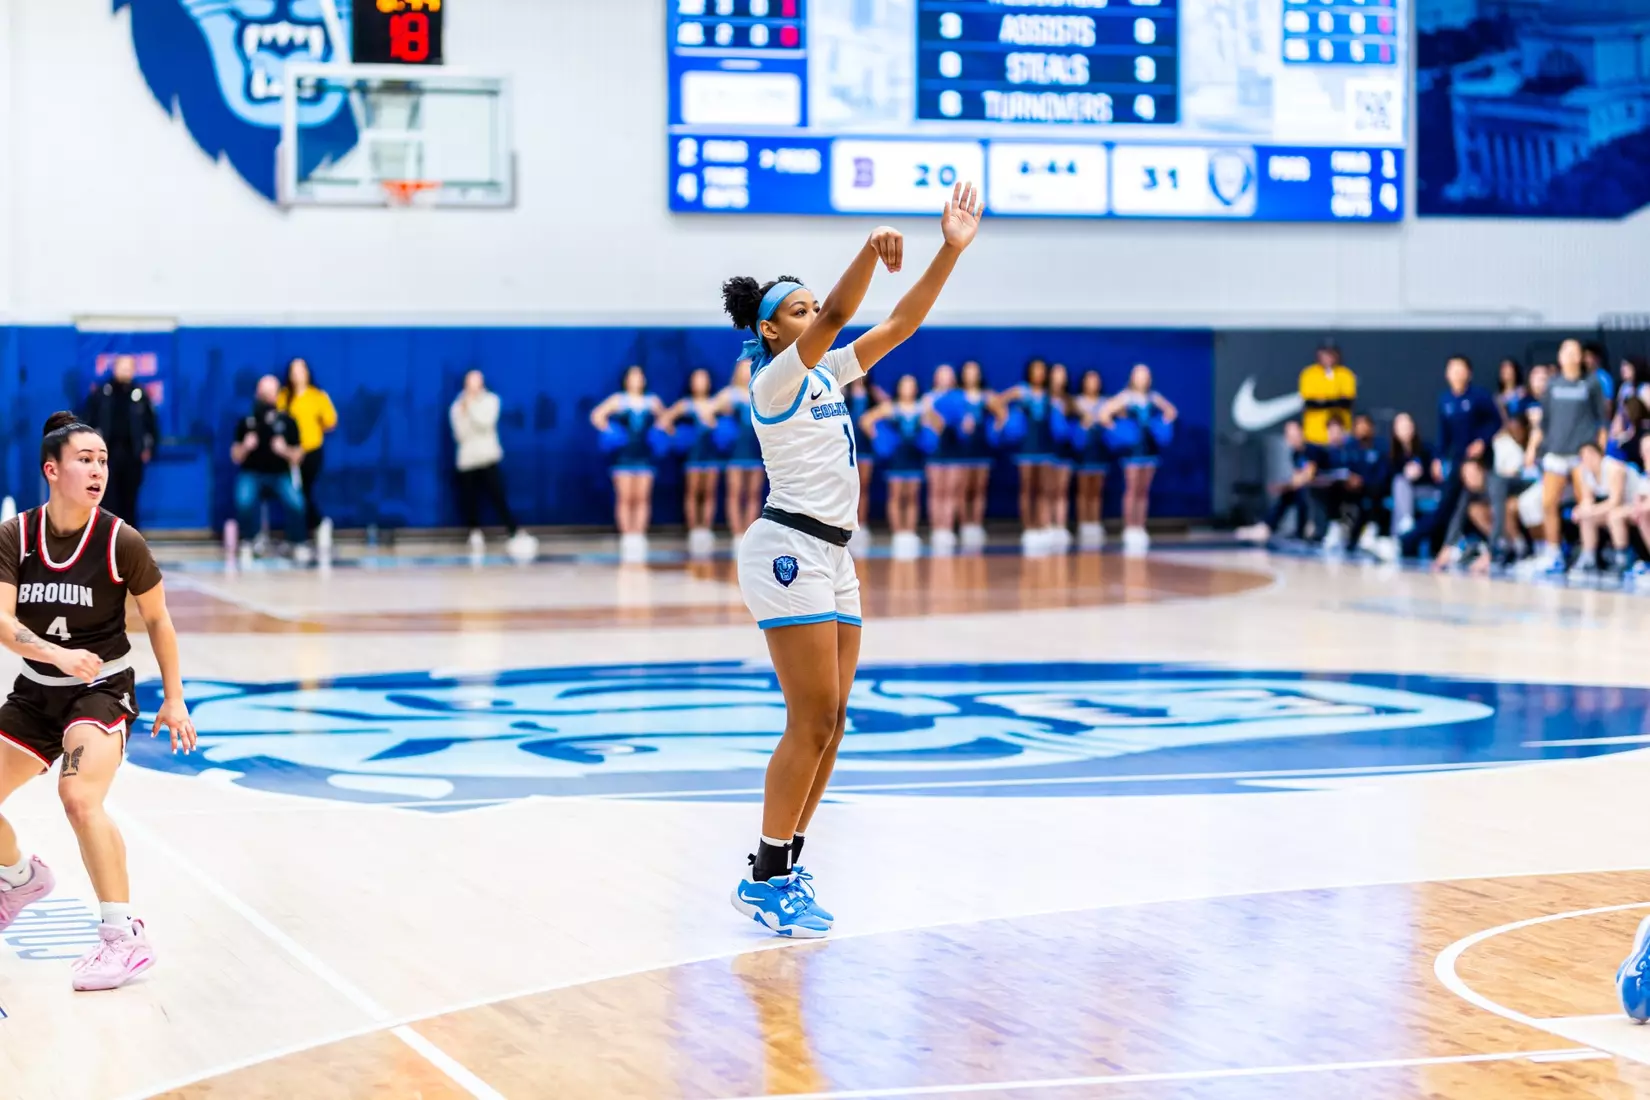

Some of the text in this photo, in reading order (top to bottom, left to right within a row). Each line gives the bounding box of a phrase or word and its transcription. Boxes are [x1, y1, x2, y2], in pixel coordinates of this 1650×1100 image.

[389, 11, 430, 62] 18
[999, 14, 1096, 46] ASSISTS
[1006, 53, 1089, 84] STEALS
[914, 163, 957, 188] 20
[1142, 167, 1179, 190] 31
[843, 423, 855, 467] 1
[18, 582, 94, 608] BROWN
[45, 616, 72, 641] 4
